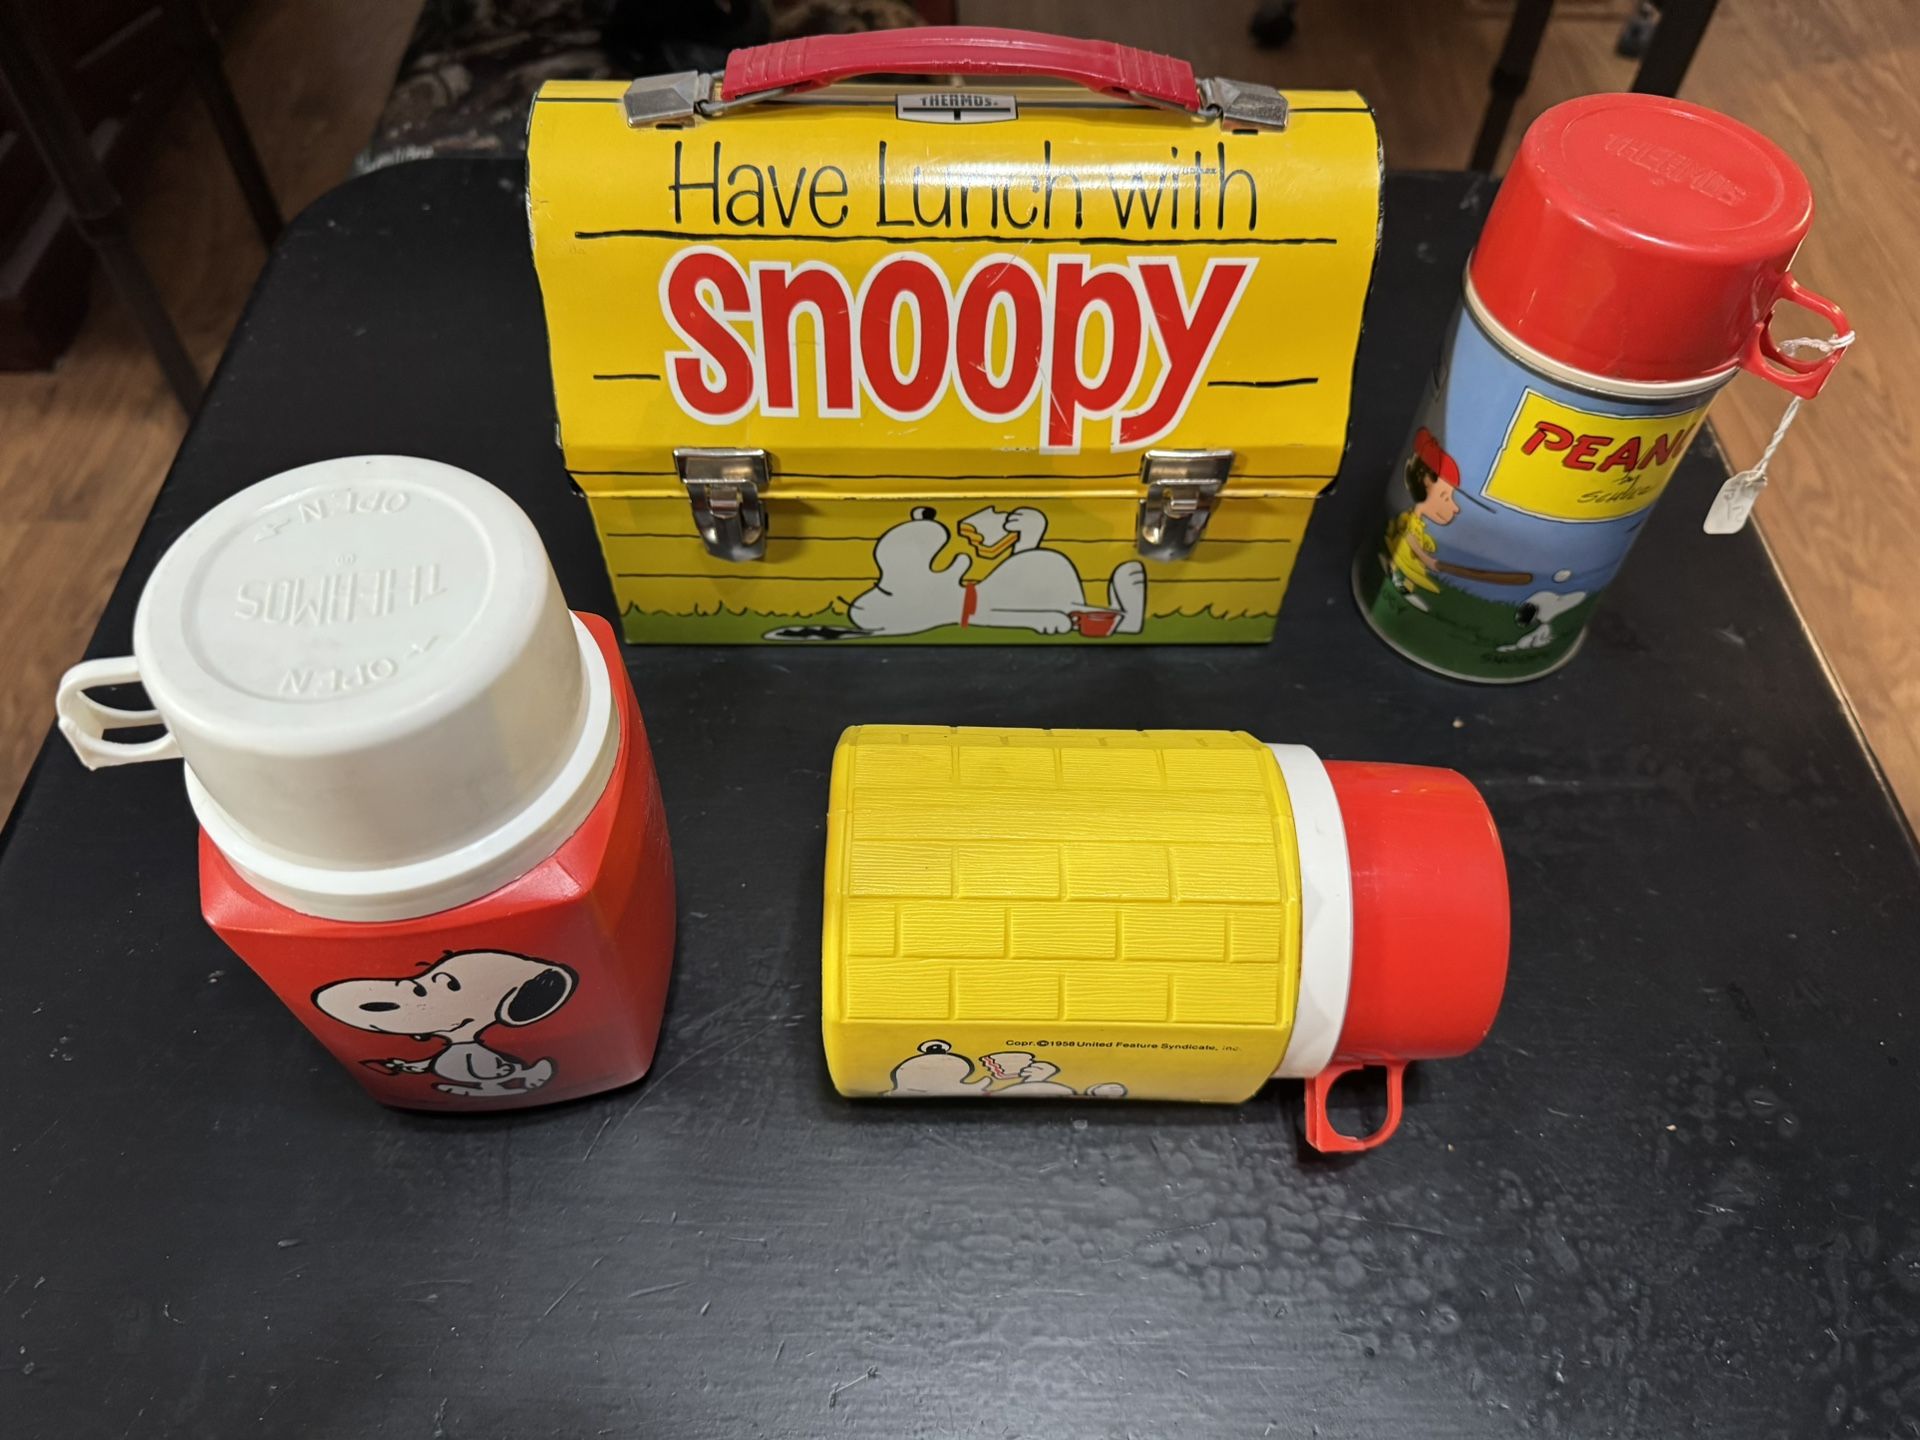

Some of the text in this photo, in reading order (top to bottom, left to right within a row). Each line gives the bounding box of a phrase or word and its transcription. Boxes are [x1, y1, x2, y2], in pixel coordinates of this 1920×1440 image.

[669, 141, 1260, 231] Have Lunch with
[1077, 1040, 1113, 1048] United
[1116, 1041, 1158, 1049] Feature
